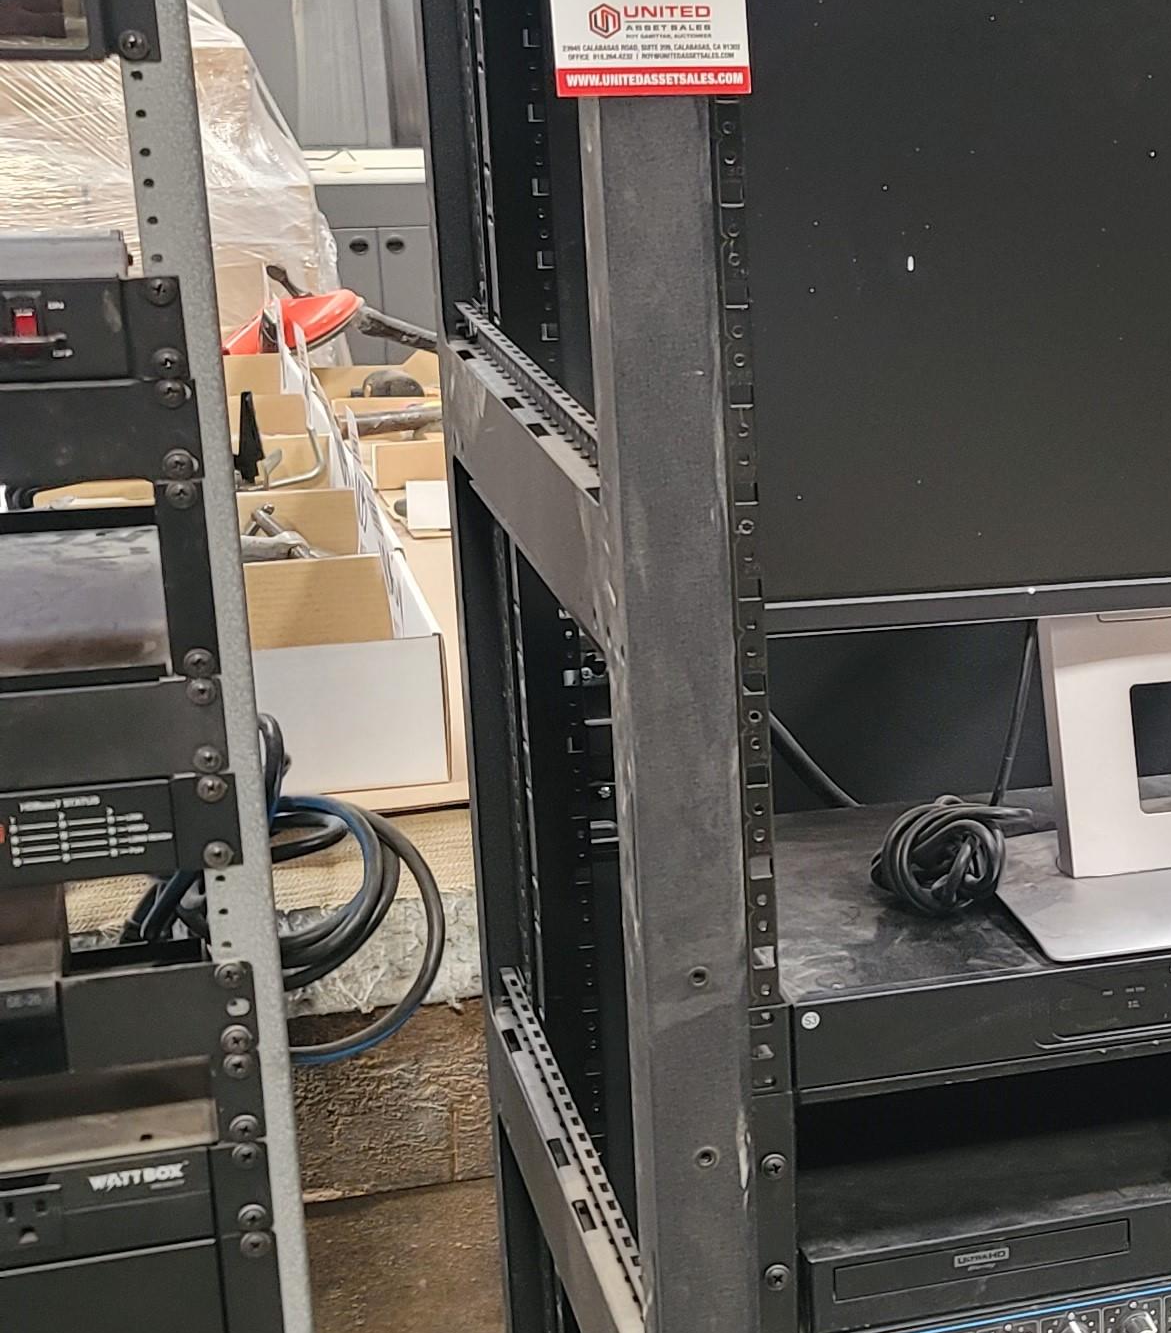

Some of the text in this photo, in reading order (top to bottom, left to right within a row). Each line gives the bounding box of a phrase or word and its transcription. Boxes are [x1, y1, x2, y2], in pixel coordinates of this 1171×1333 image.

[623, 5, 711, 18] UNITED
[625, 24, 667, 32] ASSET
[566, 71, 743, 87] WWW.UNITEDASSETSALES.COM
